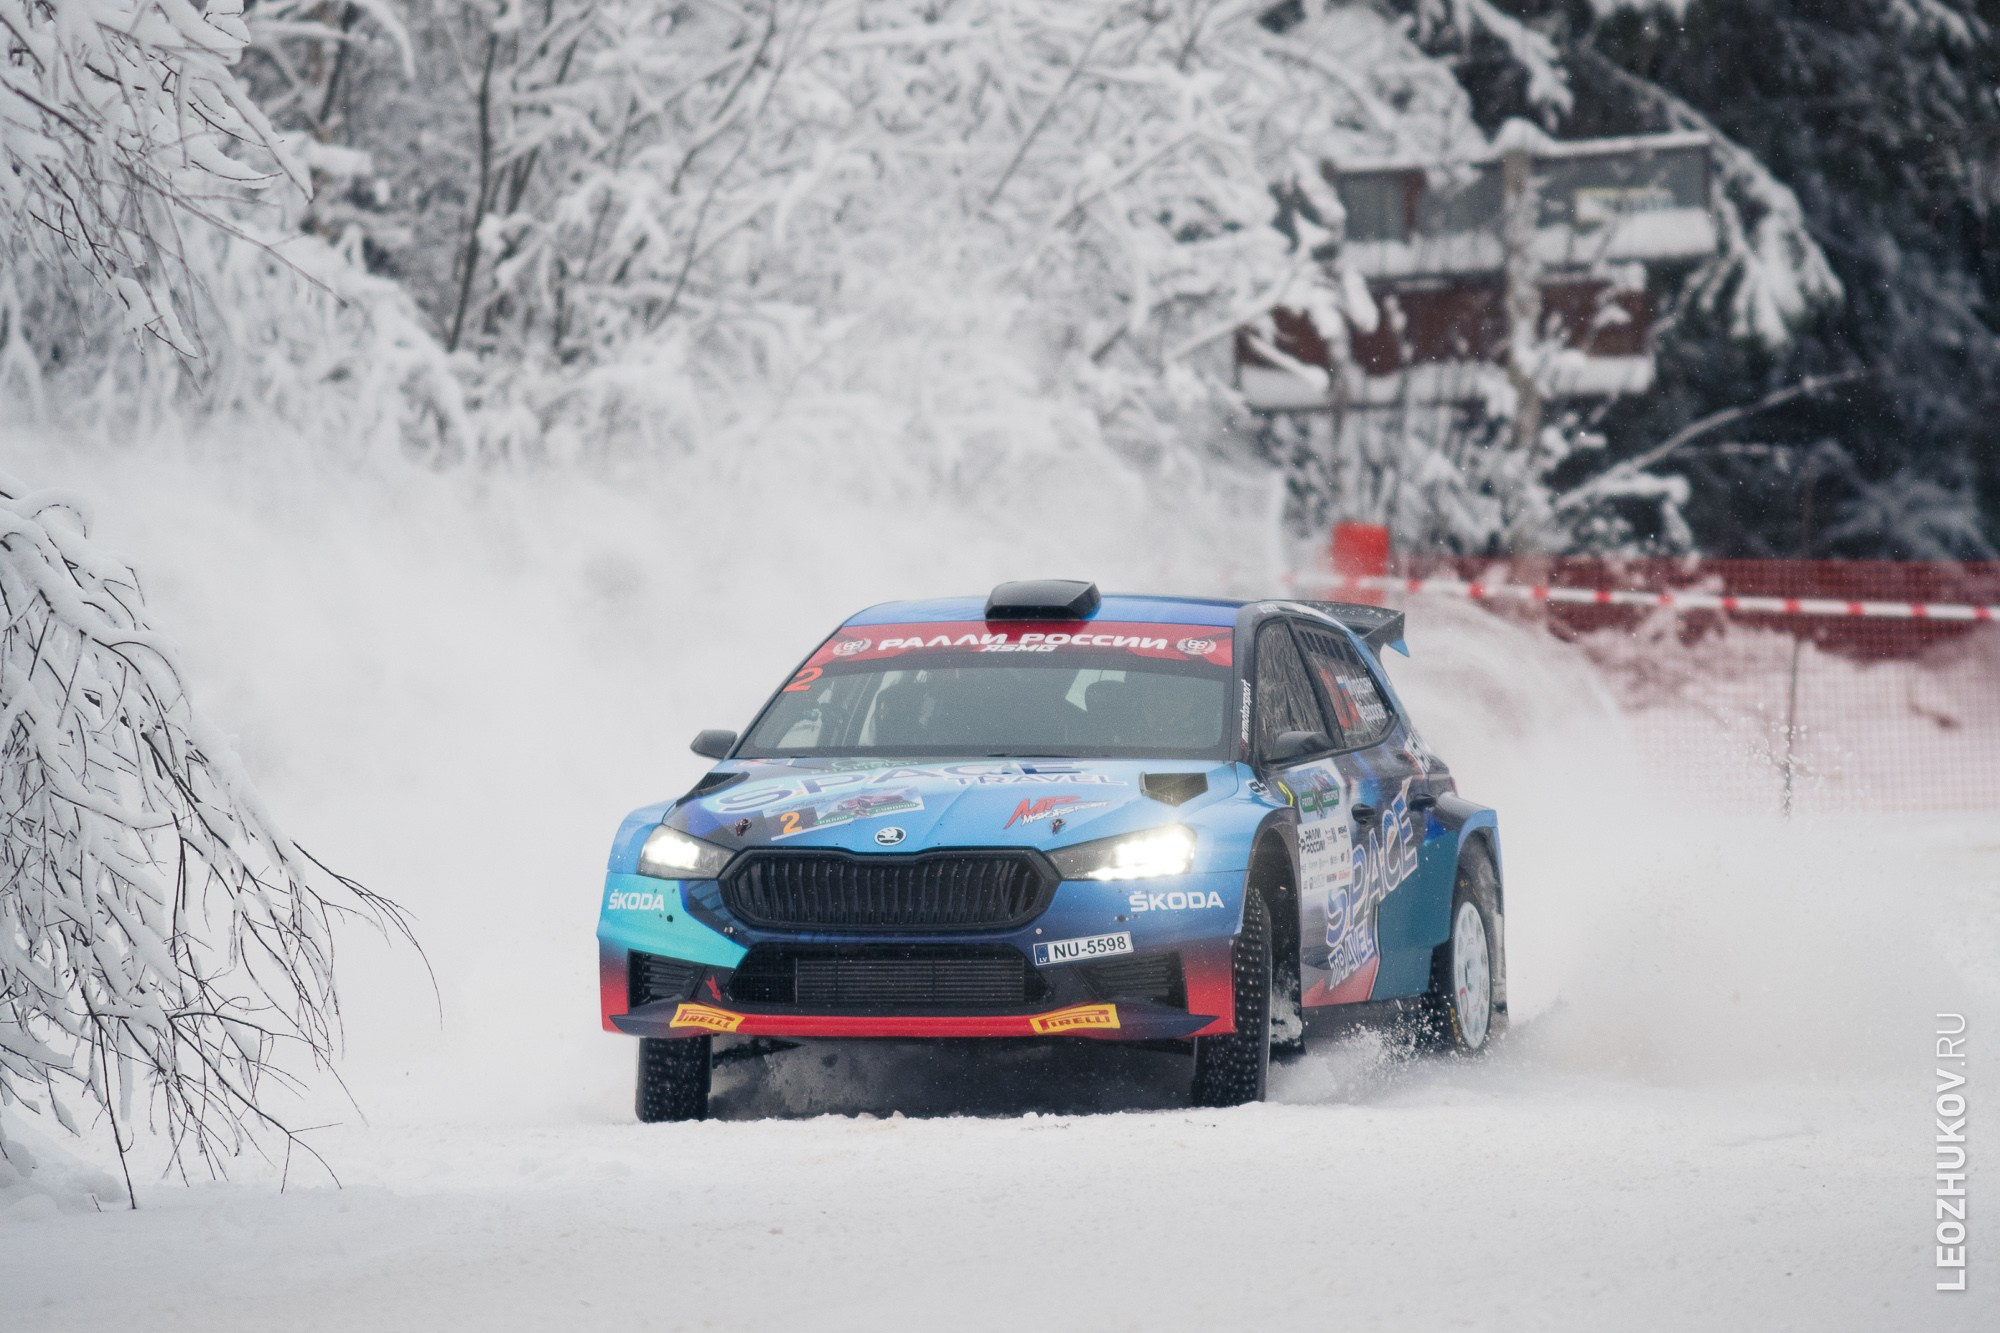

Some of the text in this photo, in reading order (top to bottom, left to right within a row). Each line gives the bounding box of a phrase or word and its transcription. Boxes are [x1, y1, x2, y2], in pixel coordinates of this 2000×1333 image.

[878, 633, 1008, 651] РАЛЛИ
[1019, 633, 1169, 650] РОССИИ
[783, 667, 824, 693] 2
[716, 761, 1083, 814] SPACE
[952, 774, 1129, 786] TRAVEL
[779, 811, 803, 835] 2
[1326, 791, 1419, 948] SPACE
[607, 888, 665, 912] ŠKODA
[1128, 890, 1225, 913] ŠKODA
[1053, 936, 1127, 960] NU-5598
[1328, 918, 1377, 991] TRAVEL
[676, 1008, 736, 1030] PIRELLI
[1038, 1009, 1111, 1031] PIRELLI
